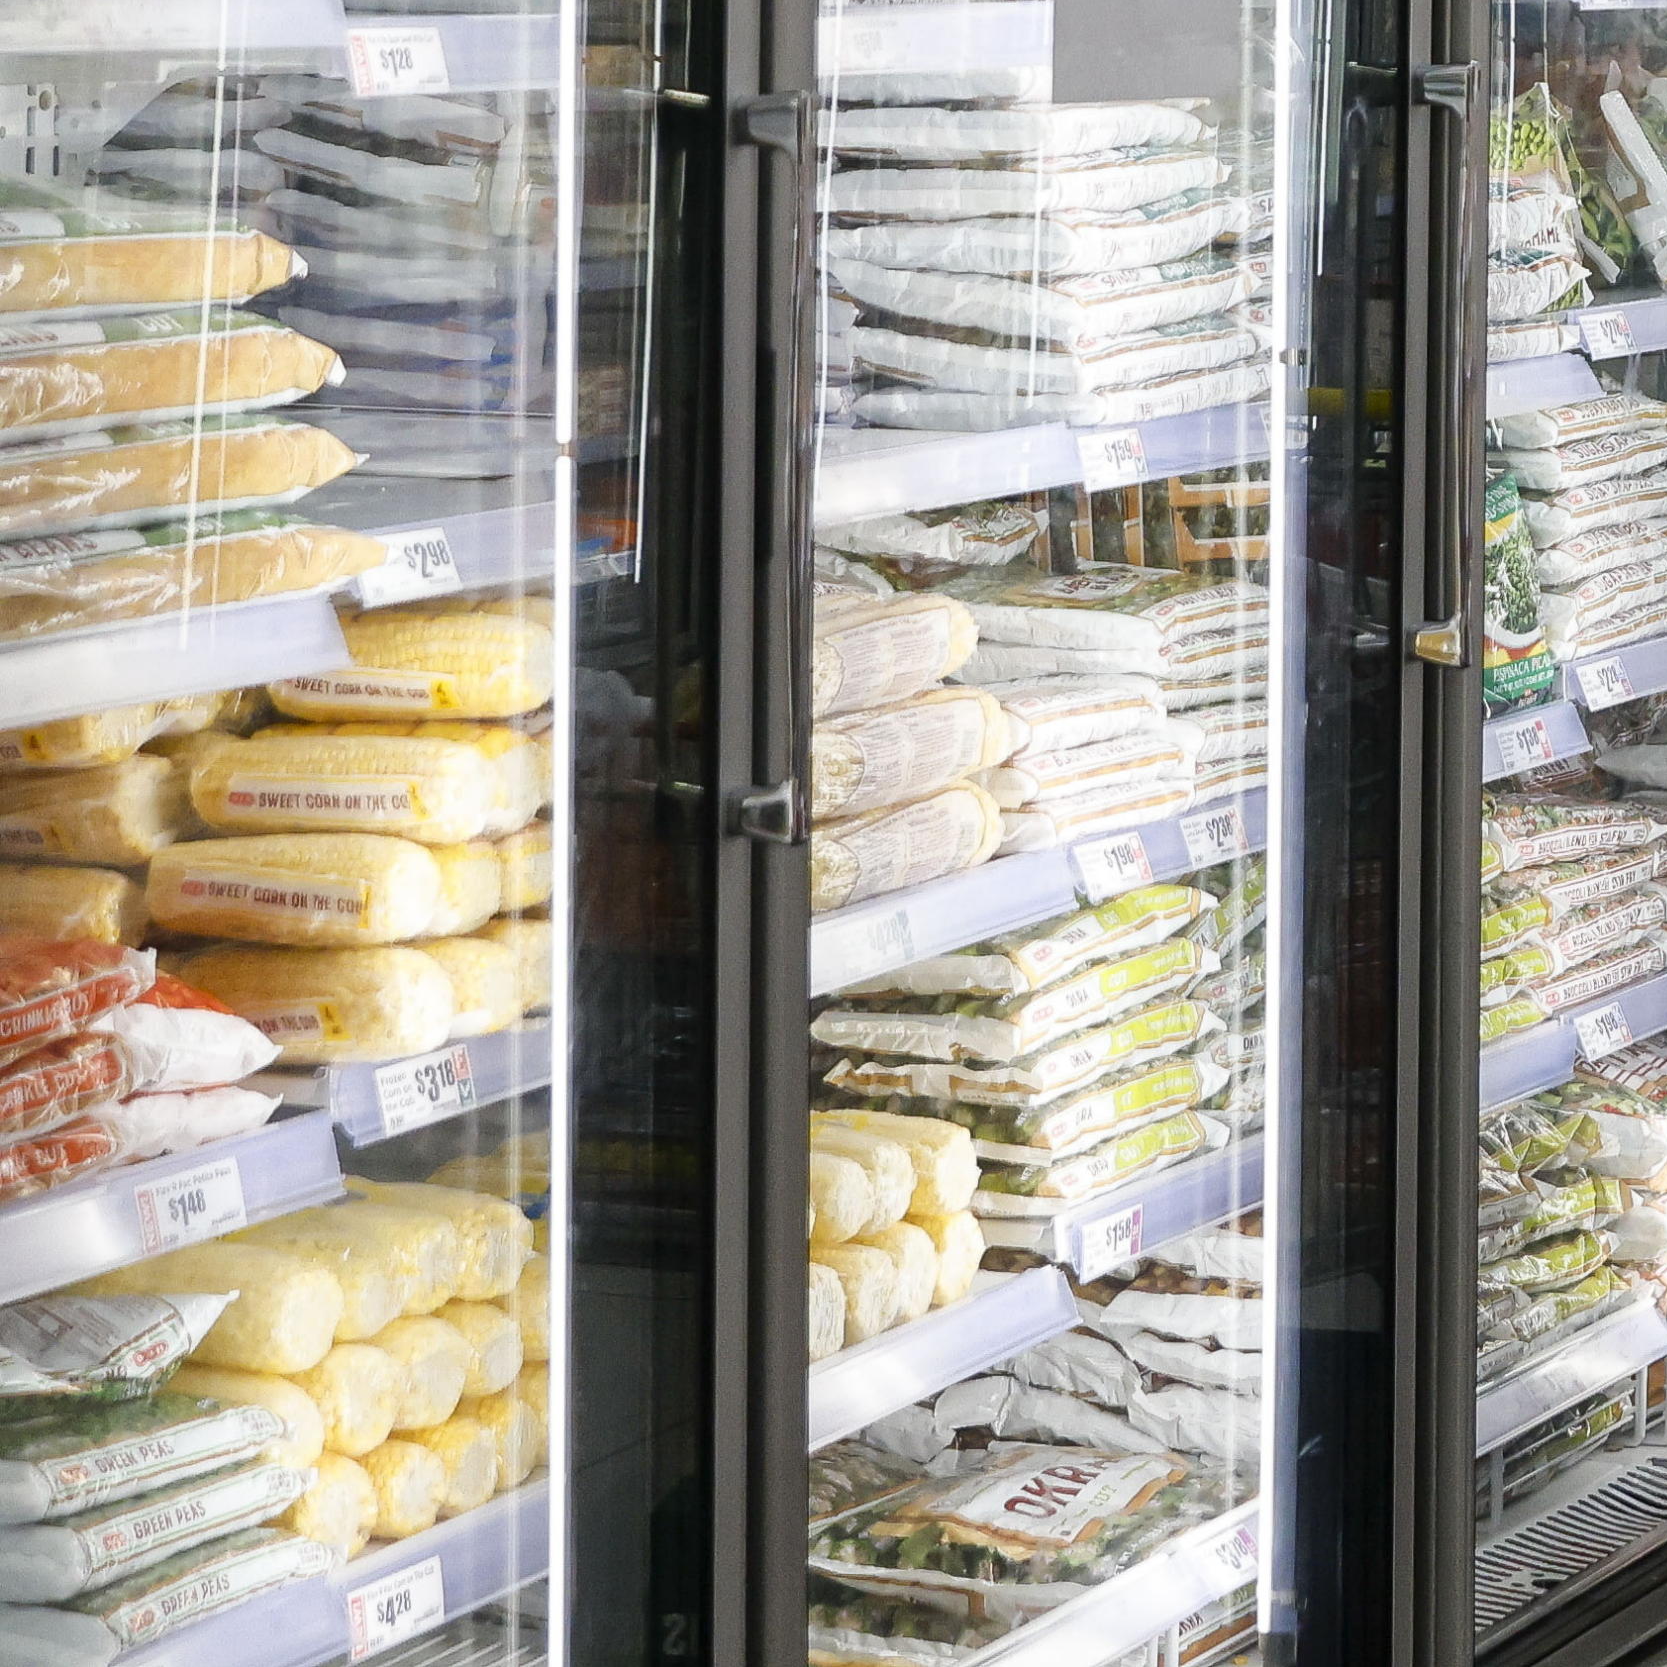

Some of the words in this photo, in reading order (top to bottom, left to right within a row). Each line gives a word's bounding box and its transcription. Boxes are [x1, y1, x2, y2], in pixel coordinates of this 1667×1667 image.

[380, 47, 414, 79] $128
[405, 537, 450, 578] $298
[258, 791, 301, 810] SWEET
[305, 792, 340, 810] CORN
[345, 794, 363, 810] ON
[365, 794, 387, 812] THE
[1206, 812, 1233, 848] $238
[1103, 841, 1136, 875] $198
[208, 880, 250, 900] SWEET
[253, 888, 288, 907] CORN
[290, 891, 309, 909] ON
[312, 892, 332, 912] THE
[415, 1061, 457, 1104] $318
[169, 1188, 207, 1228] $148
[1106, 1216, 1132, 1253] $158
[95, 1451, 137, 1473] GREEN
[140, 1440, 175, 1463] PEAS
[133, 1511, 173, 1541] GREEN
[177, 1501, 207, 1527] PEAS
[161, 1590, 199, 1617] GREEN
[200, 1574, 231, 1603] PEAS
[377, 1590, 412, 1628] $428
